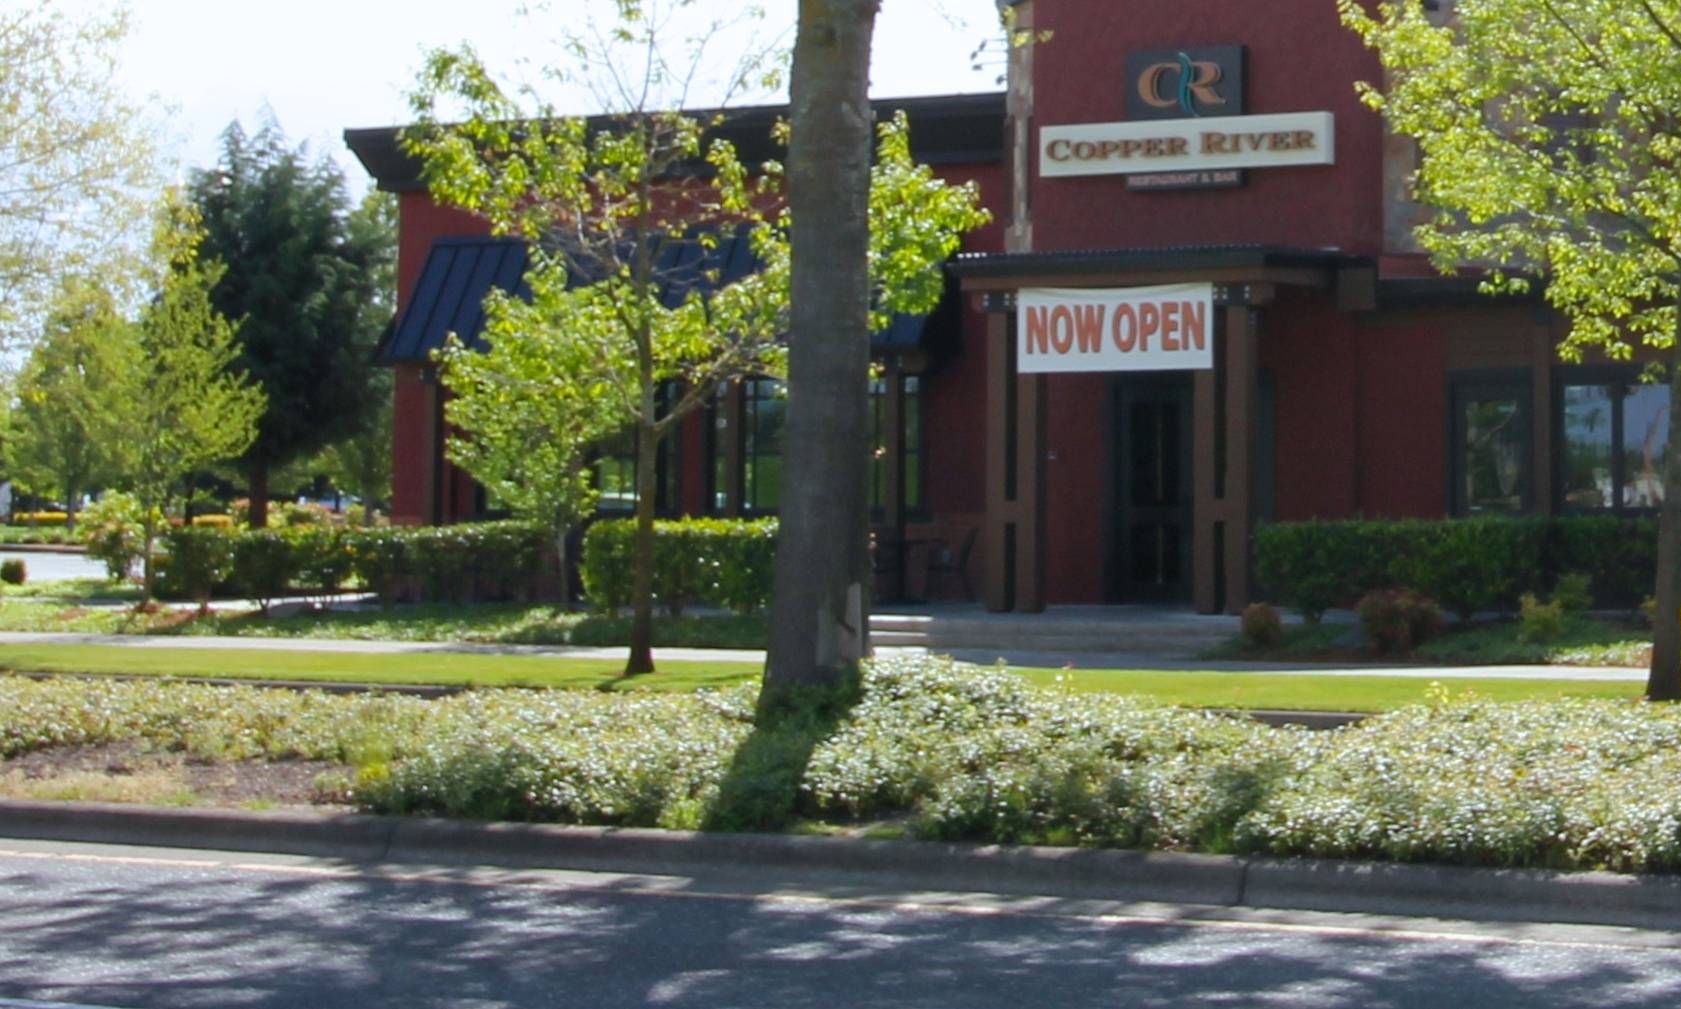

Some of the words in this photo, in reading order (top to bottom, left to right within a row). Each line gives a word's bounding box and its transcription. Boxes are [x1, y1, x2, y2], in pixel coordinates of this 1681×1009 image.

[1138, 56, 1226, 112] CR
[1046, 138, 1189, 162] COPPER
[1200, 129, 1316, 154] RIVER
[1128, 174, 1198, 187] RESTAURANT
[1213, 171, 1238, 183] BAR
[1025, 305, 1105, 355] NOW
[1112, 301, 1206, 353] OPEN
